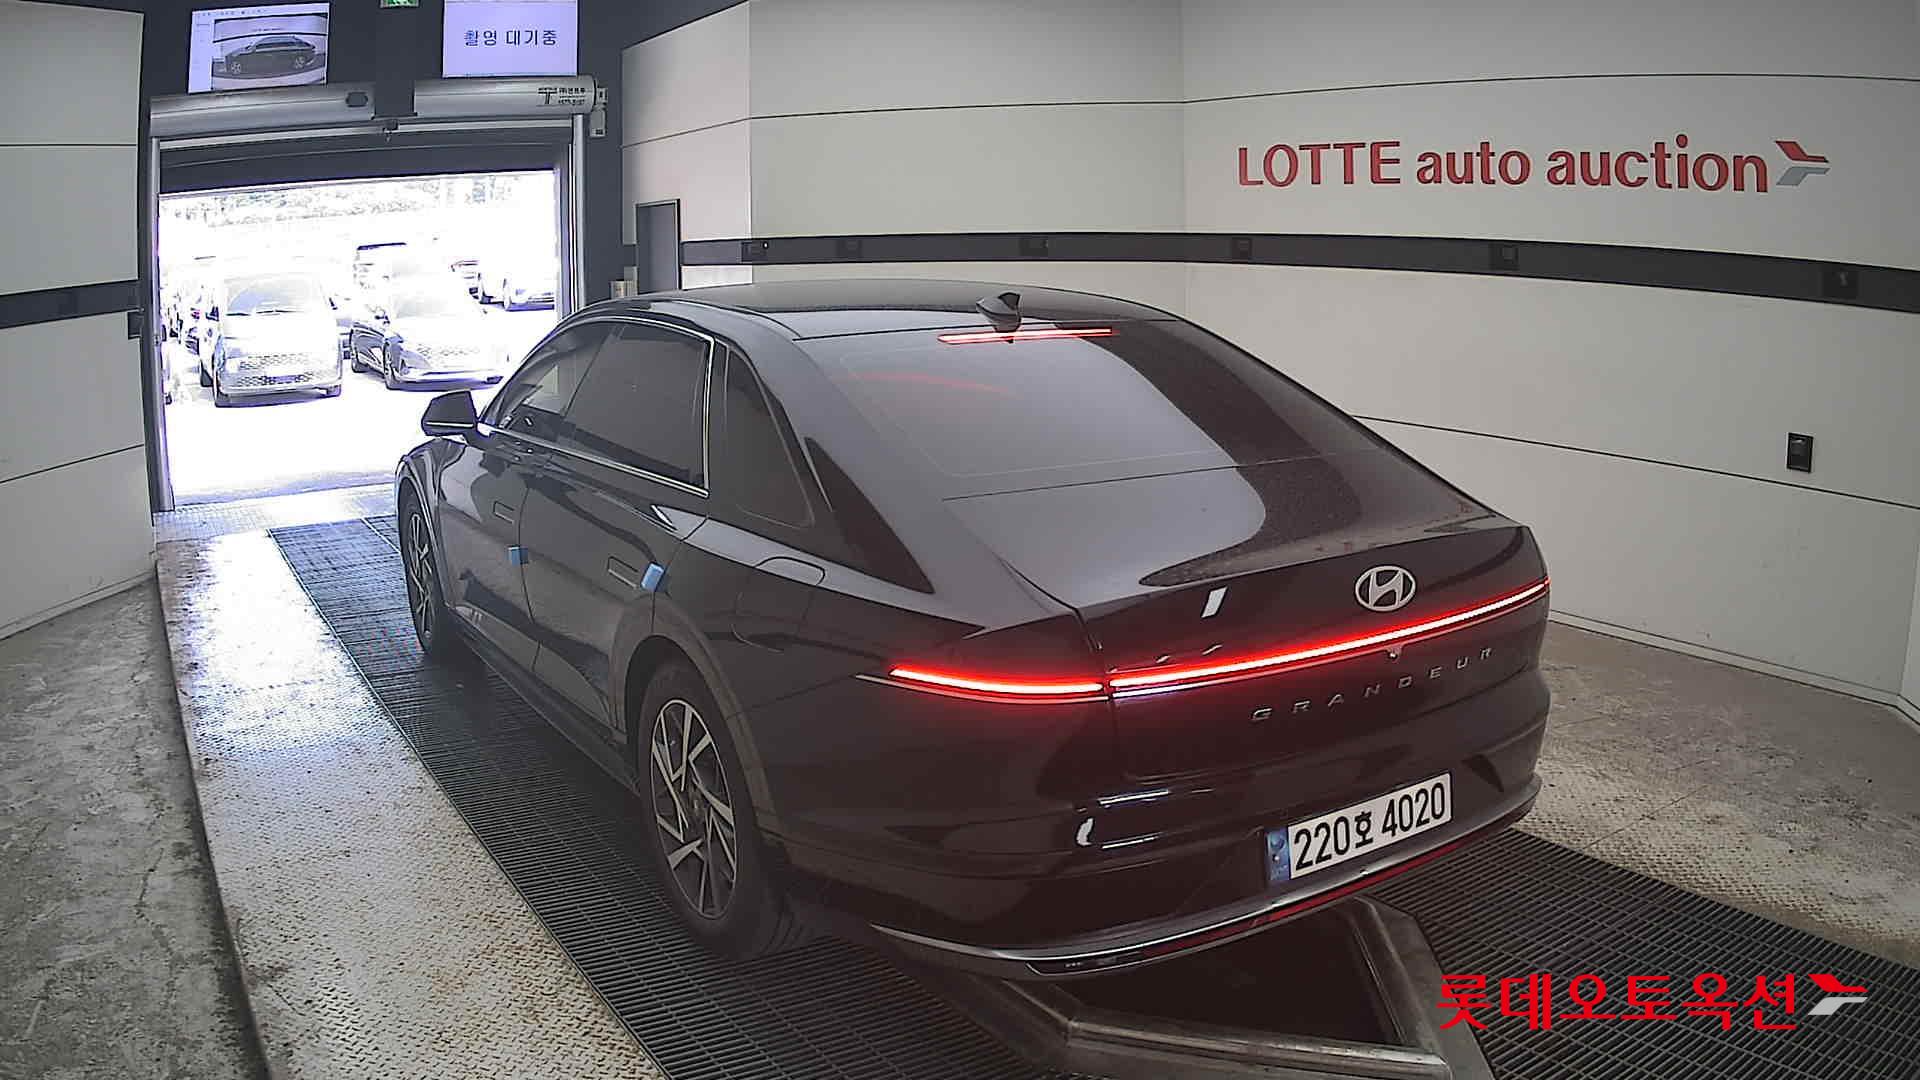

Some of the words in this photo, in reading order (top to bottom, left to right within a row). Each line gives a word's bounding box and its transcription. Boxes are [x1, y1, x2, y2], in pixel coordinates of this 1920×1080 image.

[505, 29, 557, 47] 대기중
[1238, 141, 1401, 188] LOTTE
[1416, 141, 1531, 186] auto
[1546, 134, 1769, 193] auction
[1251, 646, 1492, 721] GRANDEUR
[1293, 811, 1374, 872] 220호
[1381, 782, 1446, 838] 4020
